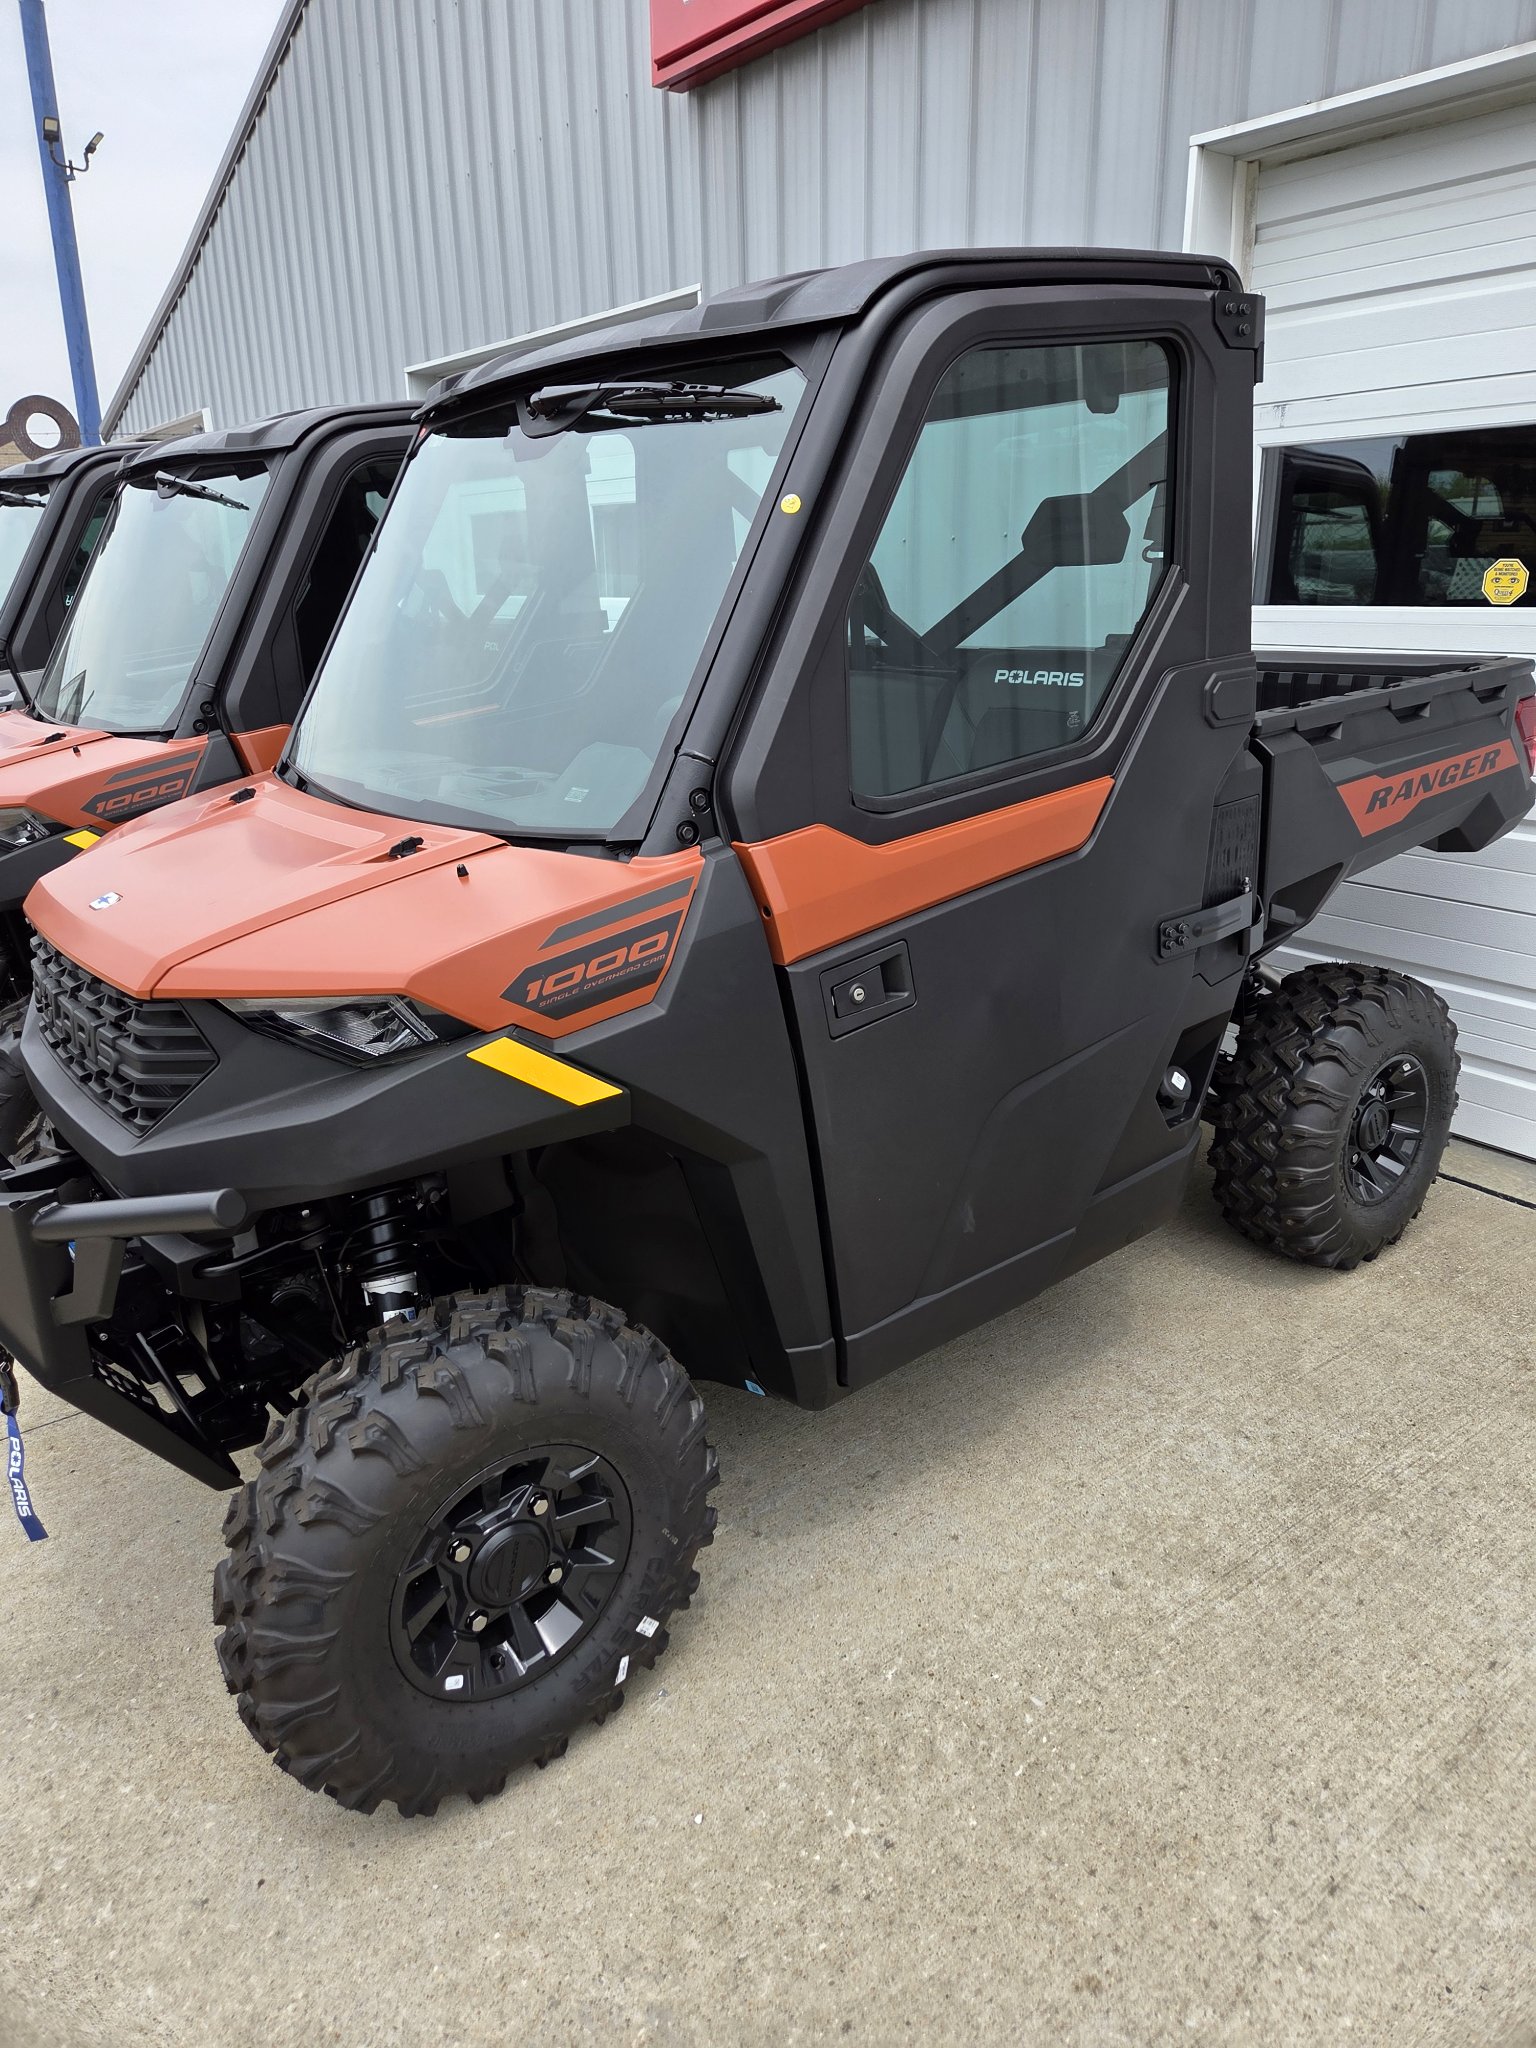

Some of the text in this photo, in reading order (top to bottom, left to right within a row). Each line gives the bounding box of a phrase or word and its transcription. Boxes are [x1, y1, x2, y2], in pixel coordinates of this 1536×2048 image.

[994, 669, 1085, 687] POLARIS
[95, 778, 185, 814] 1000
[1365, 749, 1501, 815] RANGER
[526, 930, 670, 1003] 1000
[538, 953, 666, 1008] SINGLE OVERHEAD CAM
[9, 1436, 32, 1518] POLARIS
